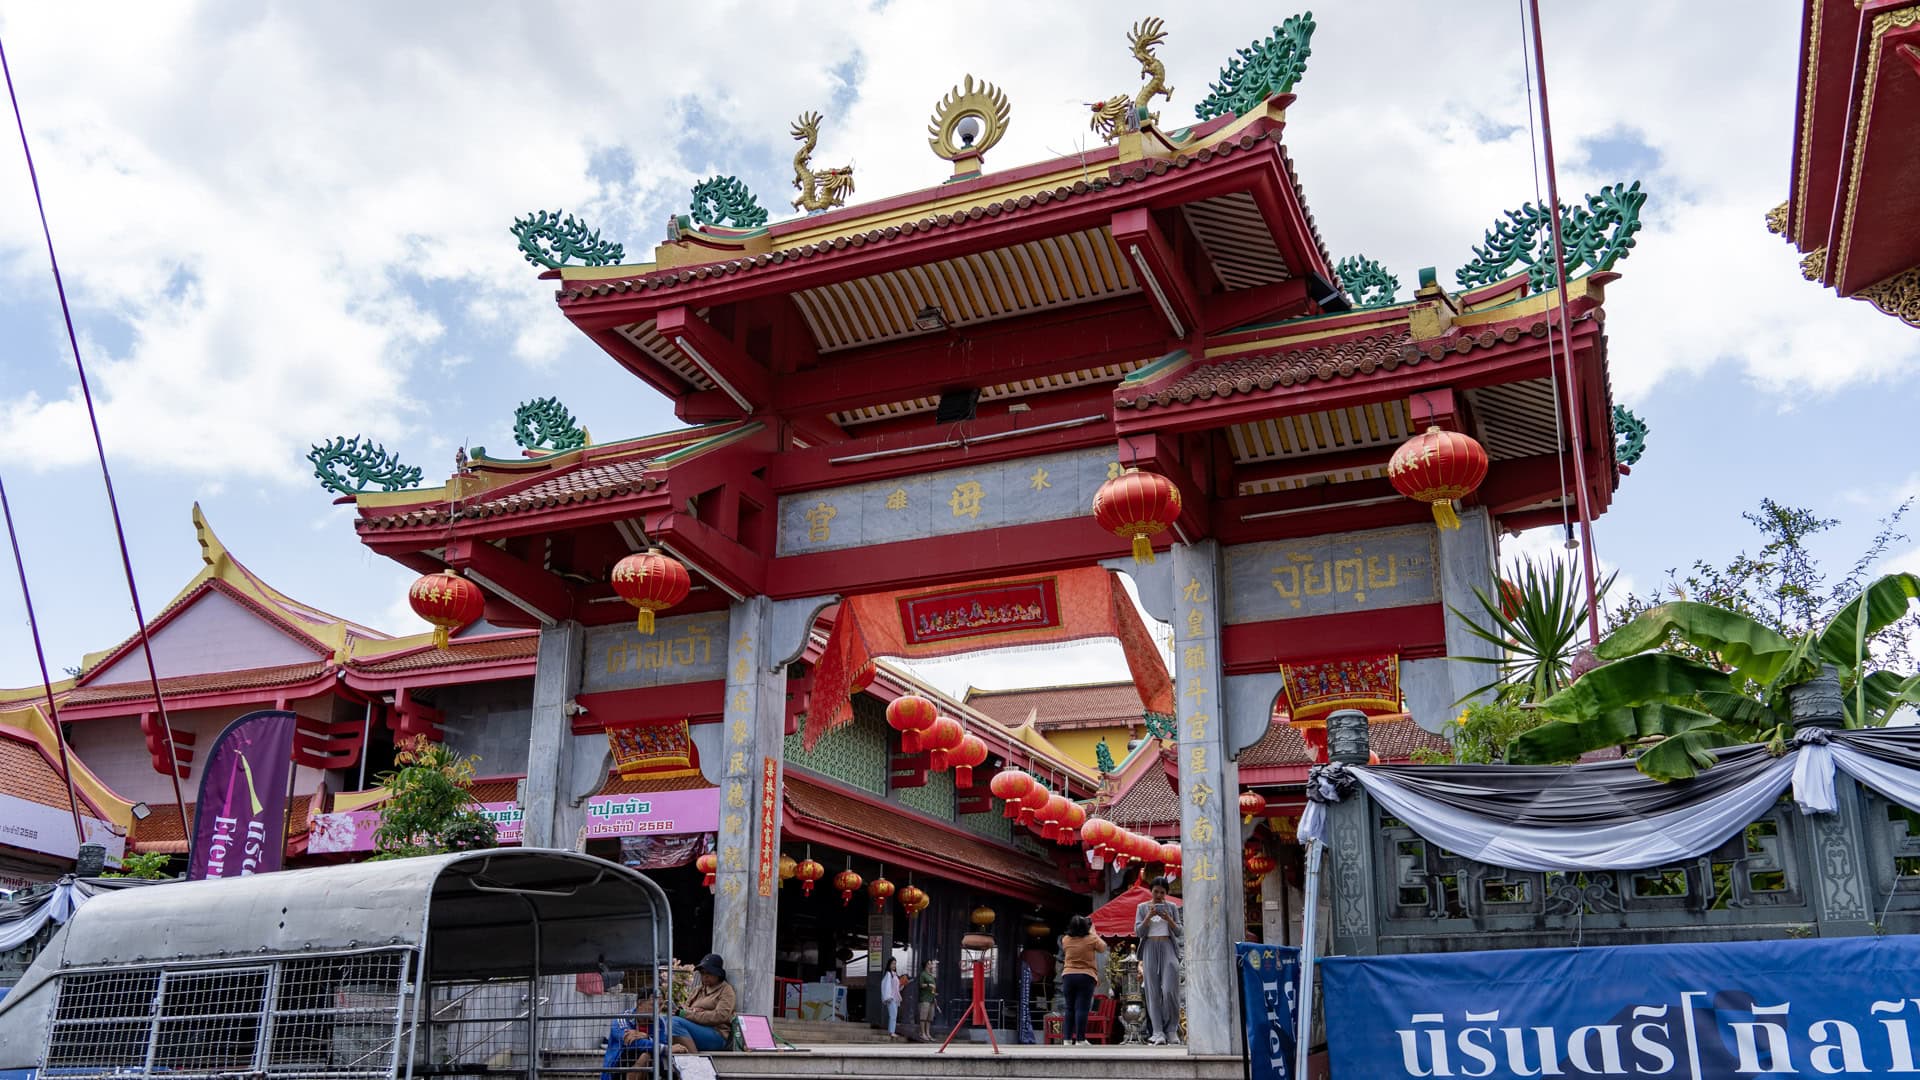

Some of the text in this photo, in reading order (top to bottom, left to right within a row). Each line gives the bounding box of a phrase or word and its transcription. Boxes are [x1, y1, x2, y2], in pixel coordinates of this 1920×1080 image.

[1271, 547, 1399, 609] จุ้ยตุ่ย
[606, 624, 712, 674] ศาลเจ้า
